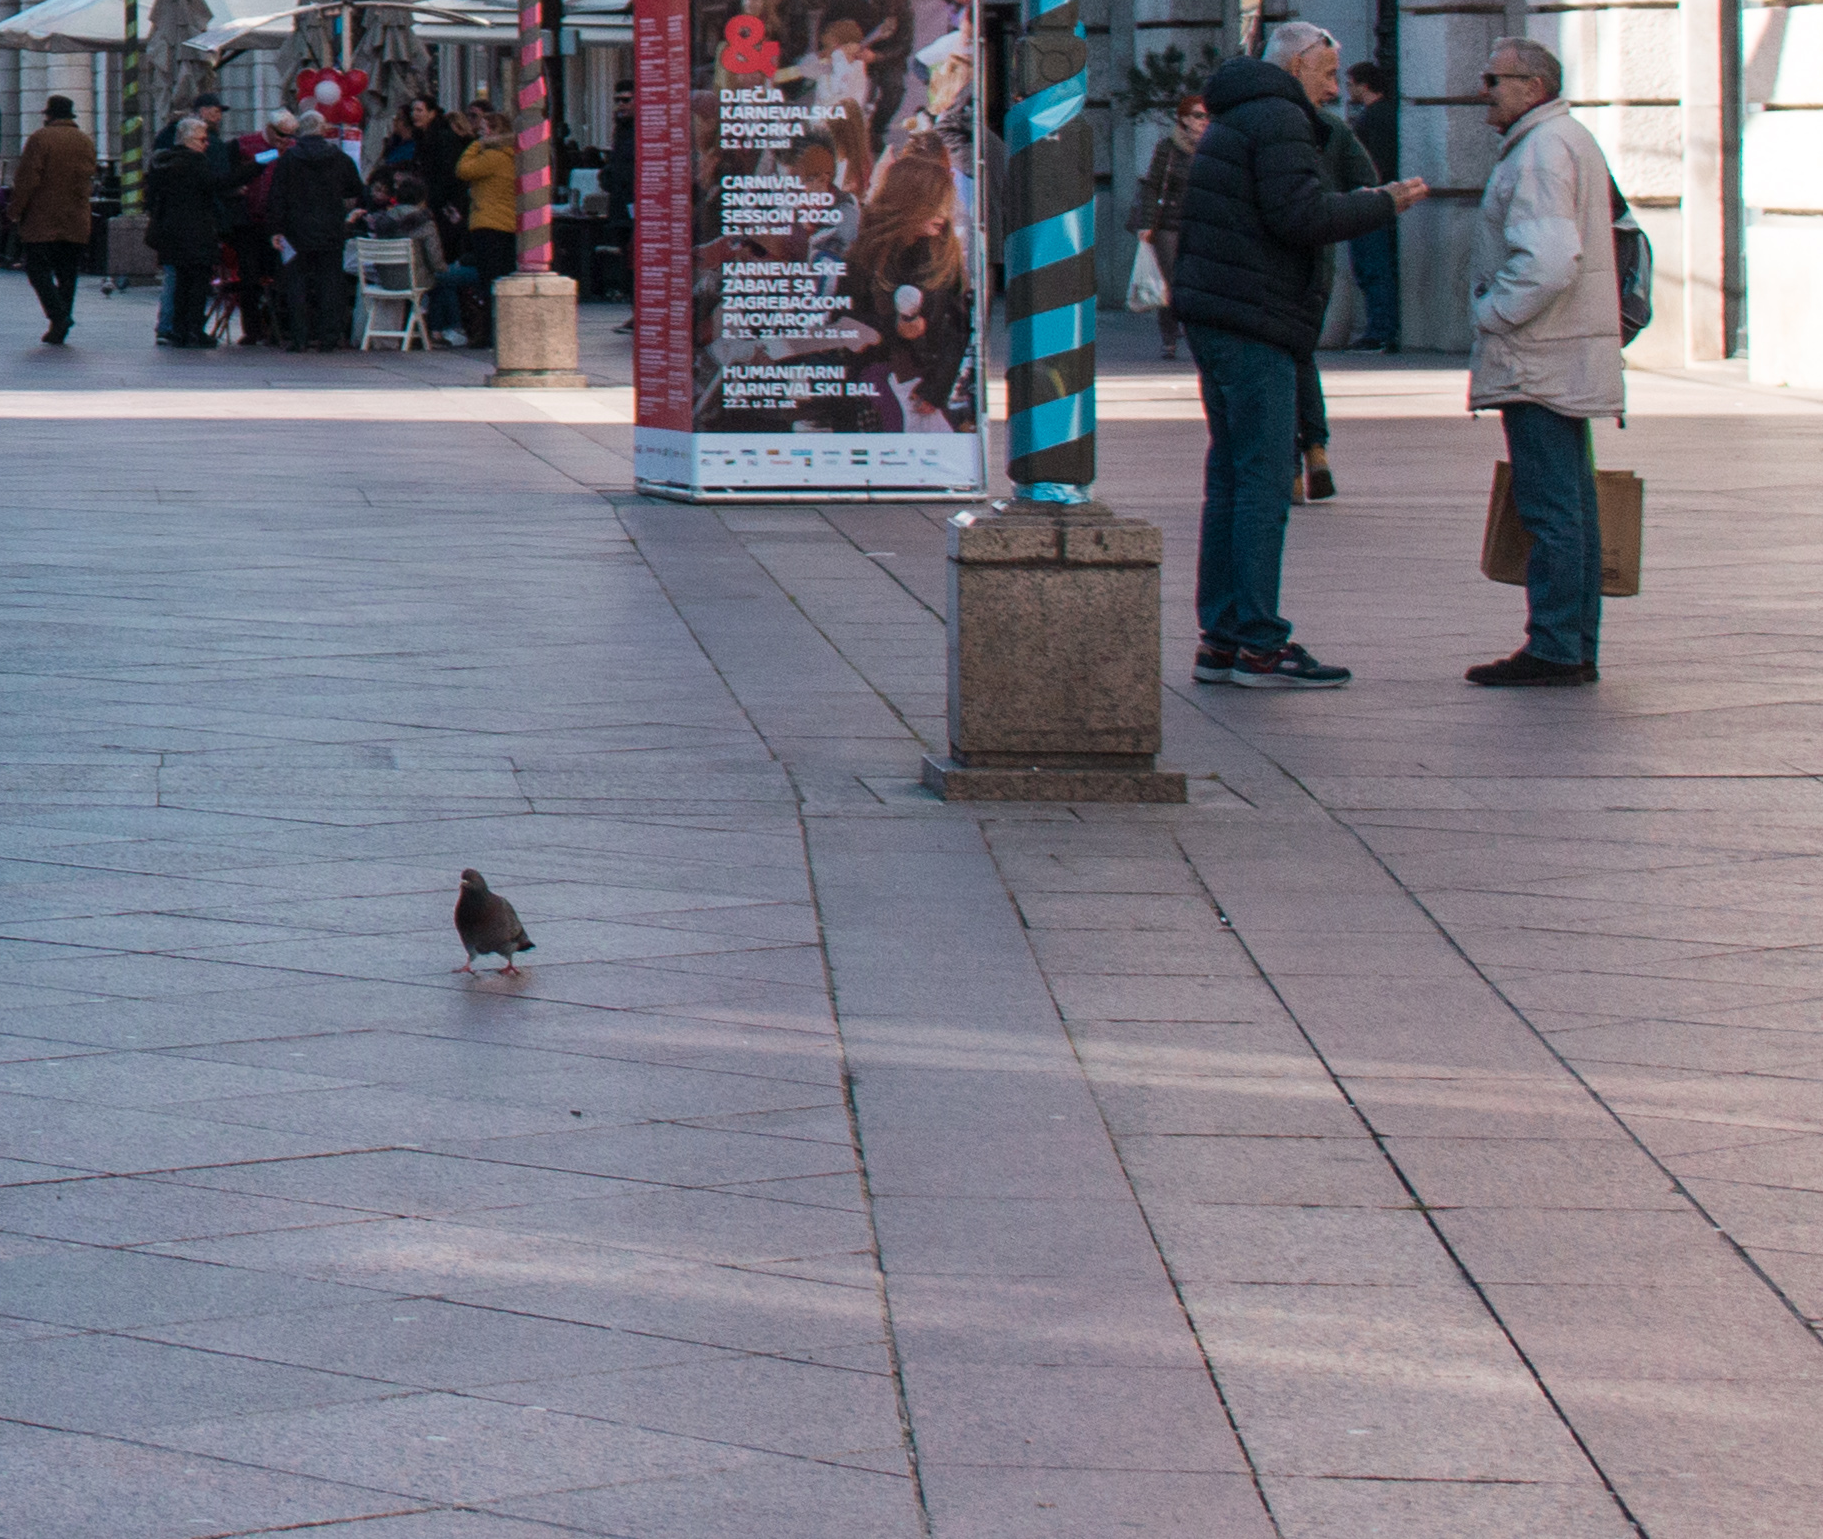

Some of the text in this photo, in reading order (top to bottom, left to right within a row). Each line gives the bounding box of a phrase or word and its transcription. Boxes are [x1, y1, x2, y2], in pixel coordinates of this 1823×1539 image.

[720, 85, 784, 103] DJEČJA
[720, 106, 847, 119] KARNEVALSKA
[720, 123, 804, 136] POVORKA
[721, 175, 806, 189] CARNIVAL
[721, 192, 834, 206] SNOWBOARD
[721, 210, 843, 223] SESSION 2020
[722, 262, 847, 276] KARNEVALSKE
[722, 279, 816, 293] ZABAVE SA
[722, 293, 851, 310] ZAGREBAČKOM
[722, 313, 824, 326] PIVOVAROM
[723, 365, 845, 379] HUMANITARNI
[723, 382, 880, 396] KARNEVALSKI BAL
